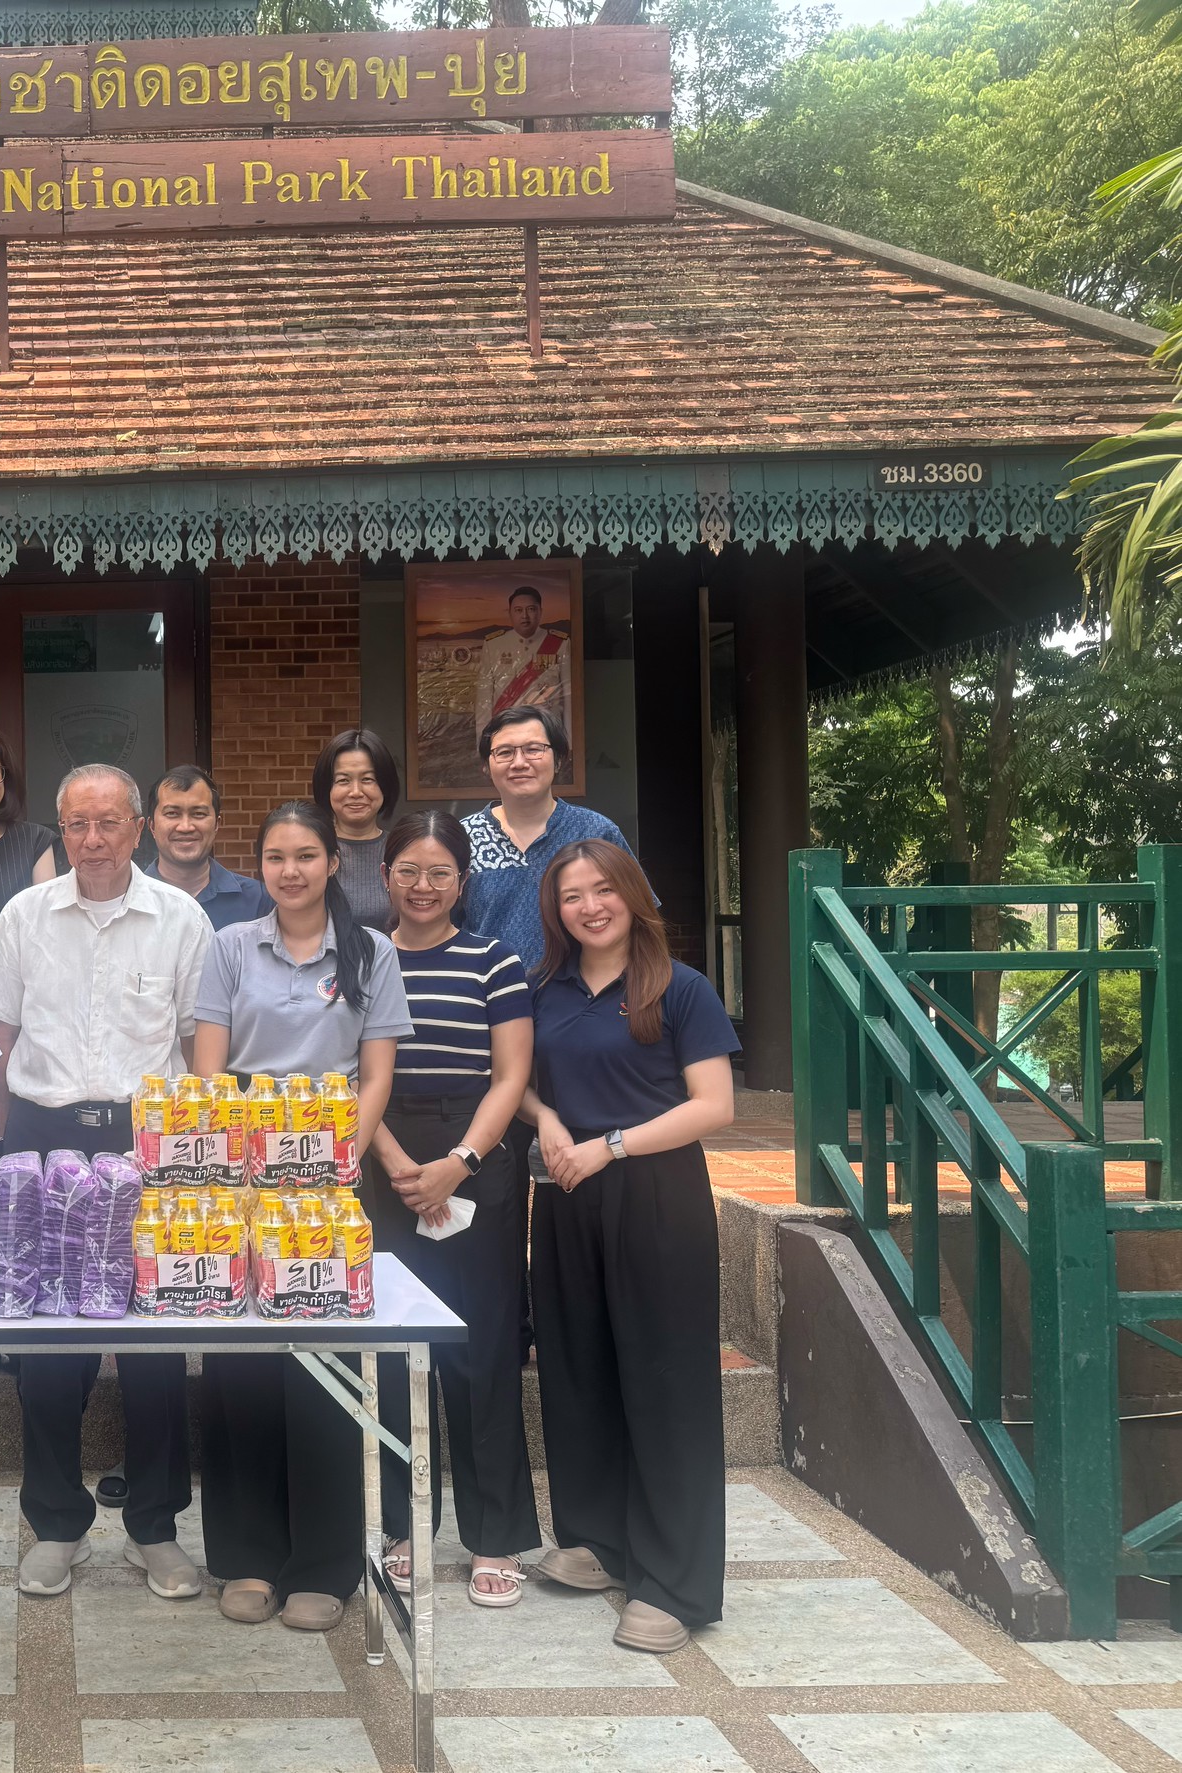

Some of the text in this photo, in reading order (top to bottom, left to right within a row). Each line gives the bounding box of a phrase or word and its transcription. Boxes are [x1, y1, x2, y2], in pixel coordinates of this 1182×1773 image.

[1, 162, 217, 214] National
[241, 158, 370, 204] Park
[391, 152, 614, 200] Thailand
[880, 462, 983, 484] ชม.3360
